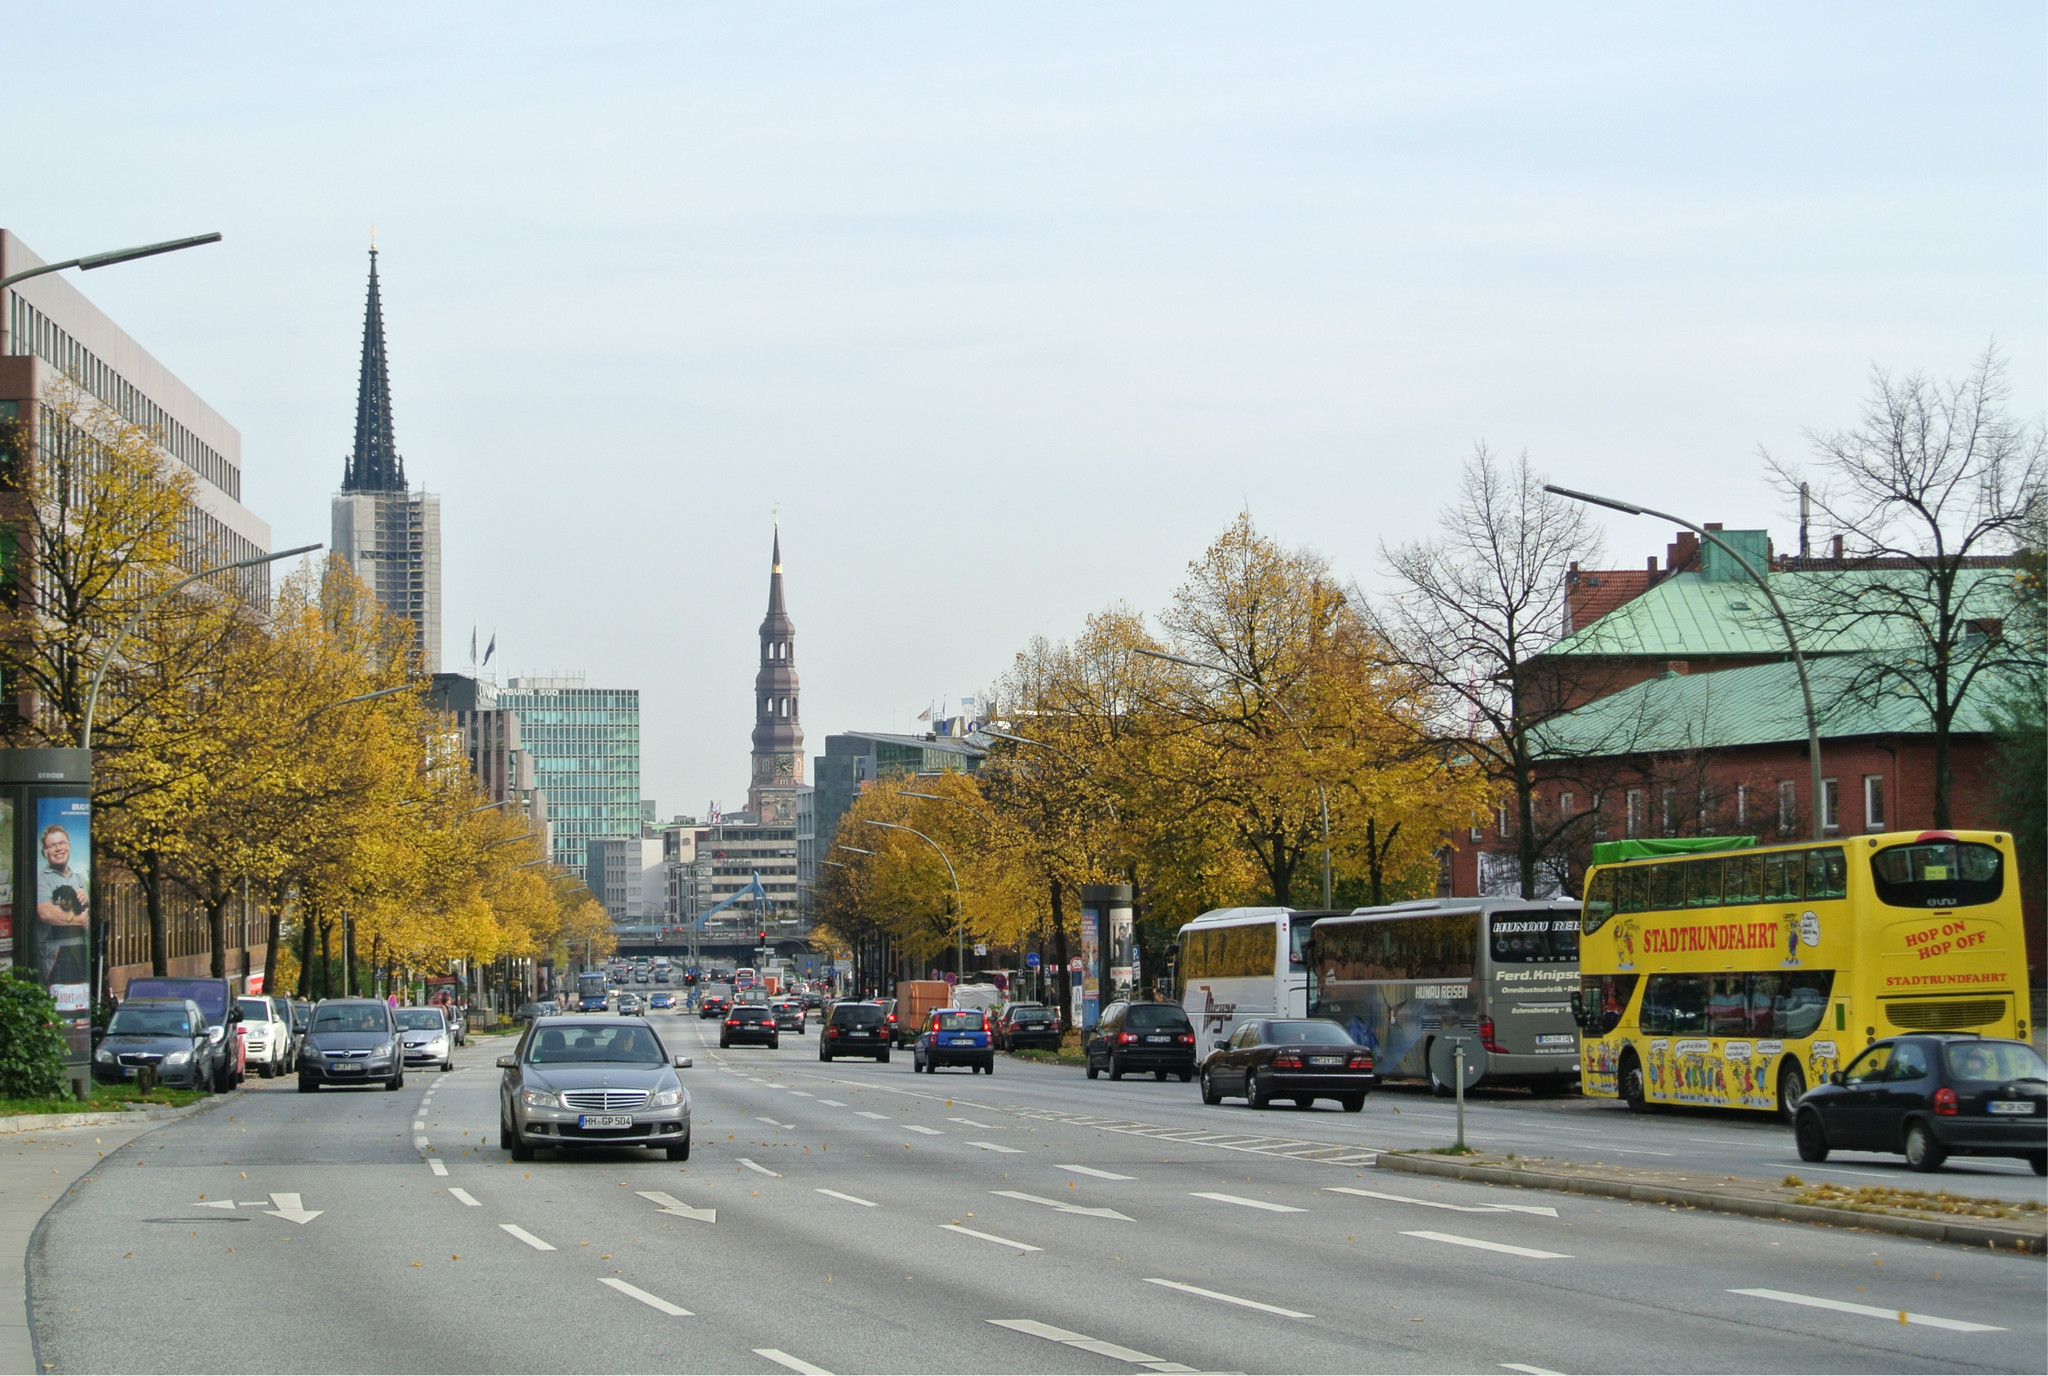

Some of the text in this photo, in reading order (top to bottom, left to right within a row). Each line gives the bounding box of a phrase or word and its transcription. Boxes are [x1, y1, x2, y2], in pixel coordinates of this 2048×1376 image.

[496, 688, 533, 696] AMBURG
[723, 859, 752, 867] Holcim
[1493, 921, 1549, 933] HUNAU
[1643, 922, 1778, 953] STADTRUNDFAHRT
[1905, 920, 1966, 948] HOP ON
[1918, 931, 1986, 960] HOP OFF
[1886, 973, 2007, 986] STADTRUNDFAHRT
[1415, 984, 1468, 999] HUNAU REISEN
[1502, 986, 1562, 994] Omnibustouristik
[615, 1116, 631, 1125] 504
